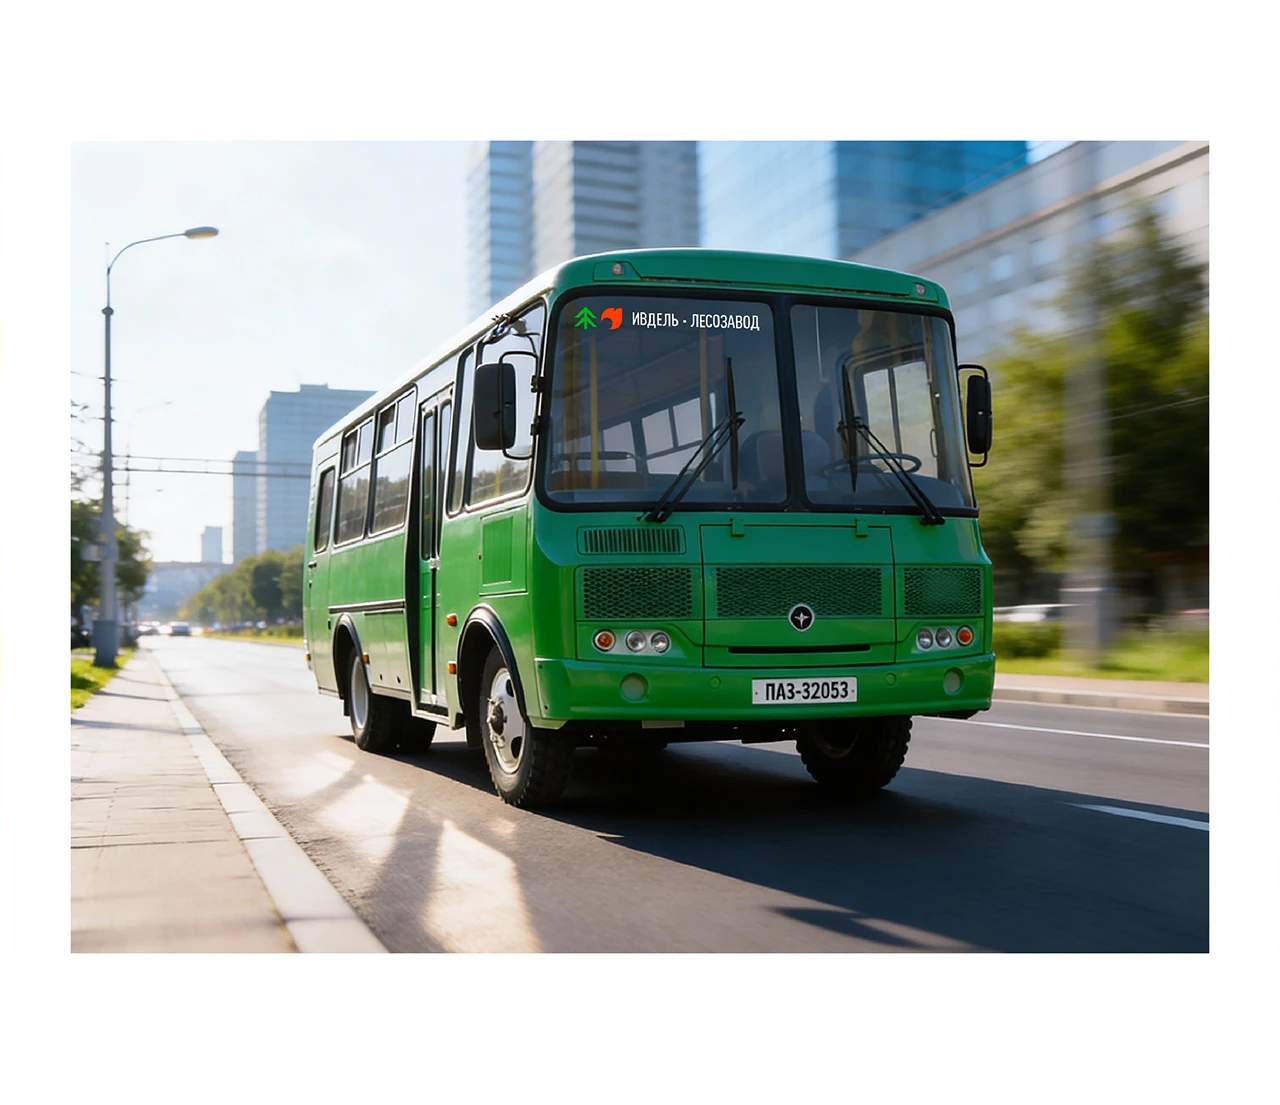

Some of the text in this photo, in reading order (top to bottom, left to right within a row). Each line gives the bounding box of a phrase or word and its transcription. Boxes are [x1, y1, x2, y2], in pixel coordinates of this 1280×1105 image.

[632, 311, 679, 329] ИВДЕЛЬ
[690, 313, 760, 331] ЛЕСОЗАВОД
[765, 681, 849, 701] ПАЗ-32053
